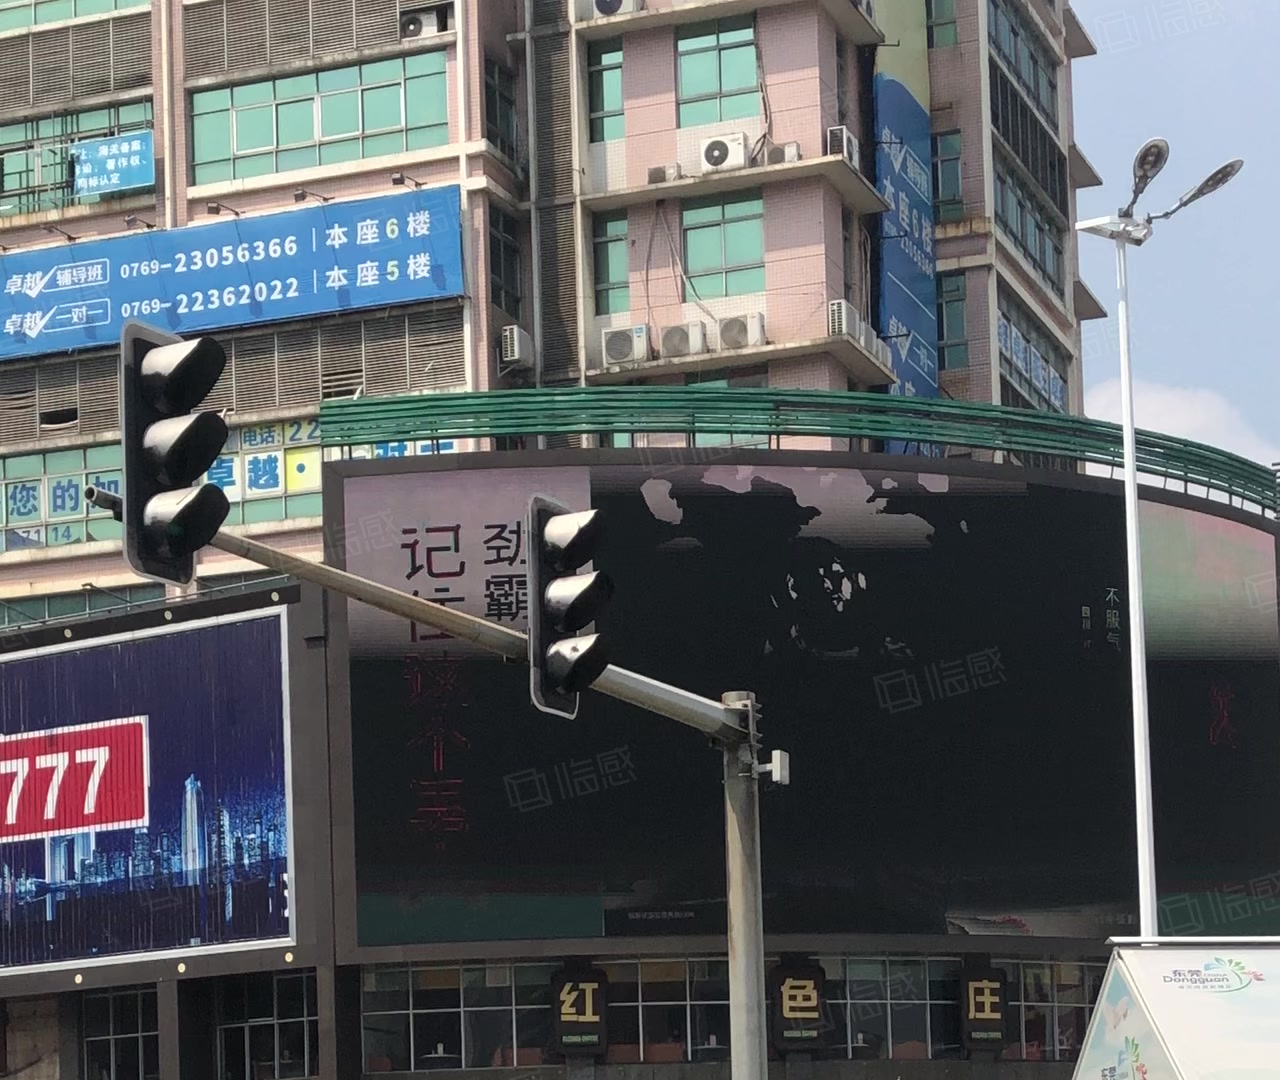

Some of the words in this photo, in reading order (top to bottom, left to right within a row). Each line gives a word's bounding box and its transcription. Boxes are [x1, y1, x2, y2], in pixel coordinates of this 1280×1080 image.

[4, 269, 45, 296] 卓越
[56, 265, 103, 288] 辅导班
[120, 236, 298, 280] 0769-23056366
[325, 211, 431, 249] 本座6楼
[4, 309, 45, 336] 卓越
[56, 306, 104, 324] 一对一
[120, 278, 299, 318] 0769-22362022
[325, 253, 431, 292] 本座5楼
[781, 977, 819, 1019] 色
[968, 980, 1001, 1020] 庄
[1162, 975, 1230, 984] Dongguan
[559, 982, 600, 1023] 红
